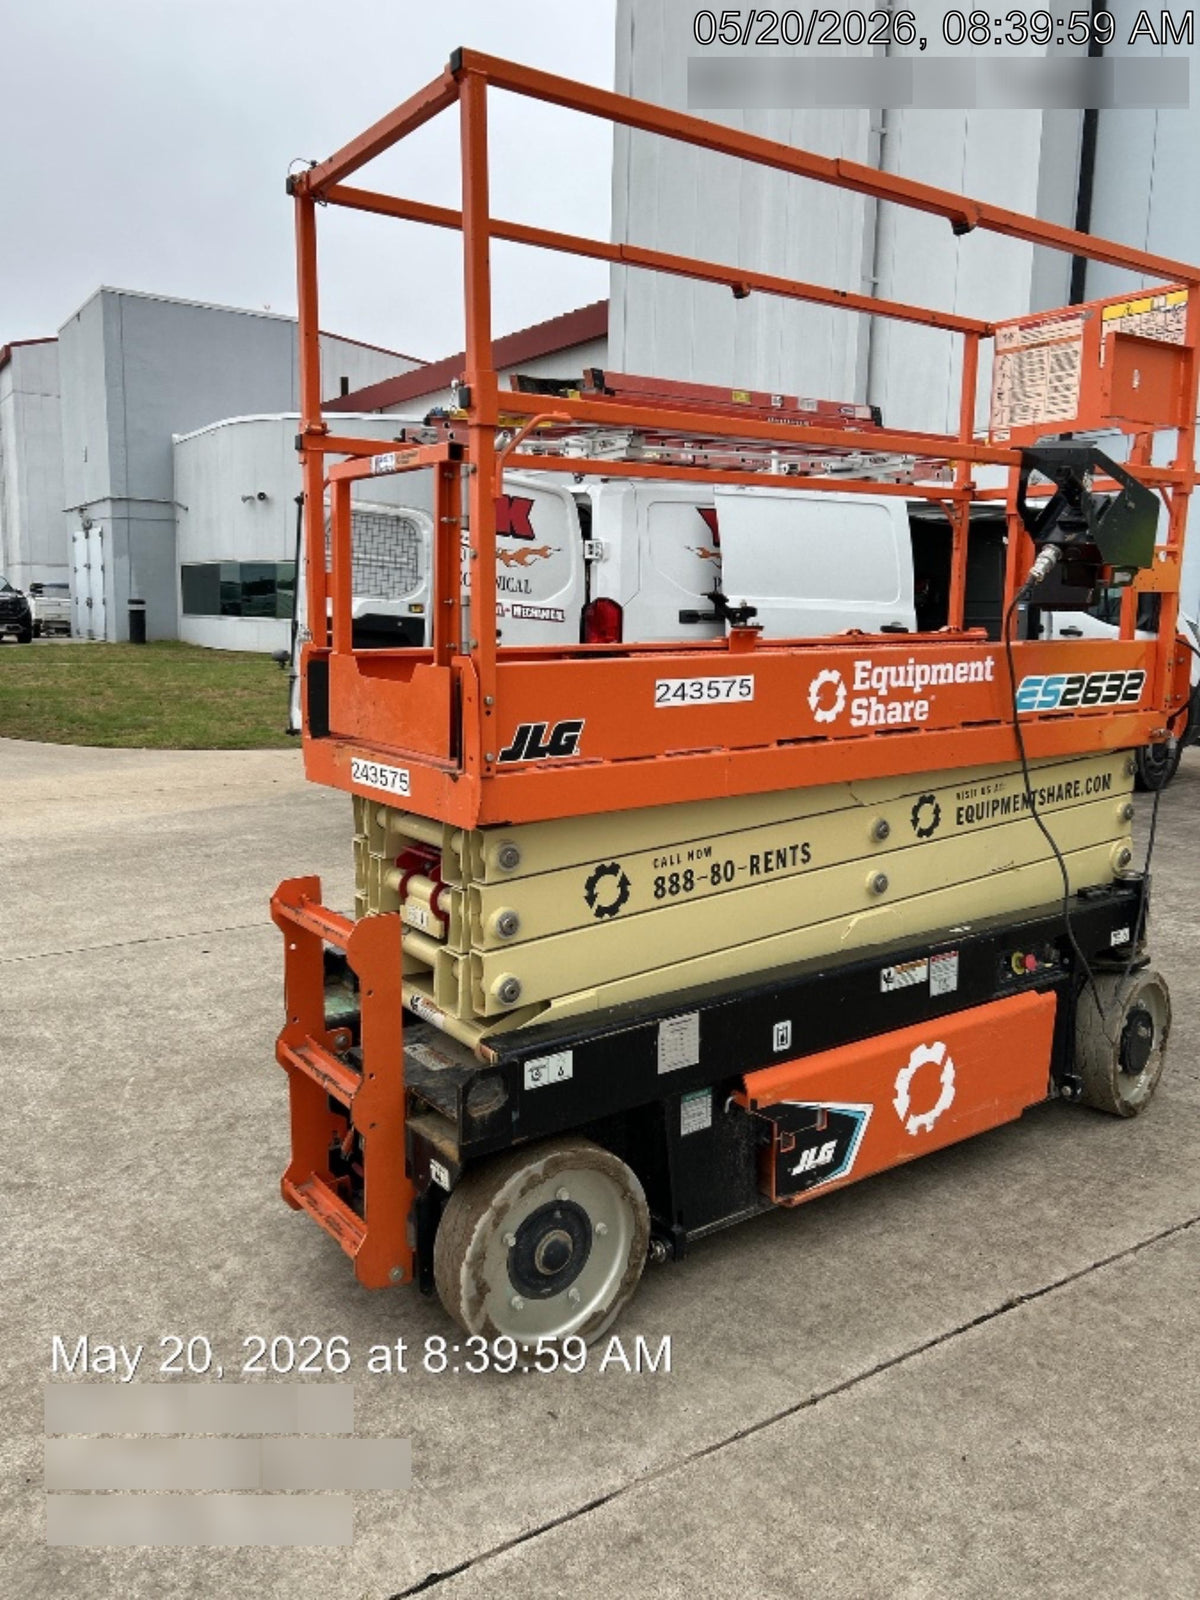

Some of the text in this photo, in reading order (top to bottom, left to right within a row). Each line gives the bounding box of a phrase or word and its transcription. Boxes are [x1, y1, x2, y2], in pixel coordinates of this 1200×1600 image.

[655, 677, 752, 703] 243575
[853, 656, 995, 691] Equipment
[1015, 669, 1147, 713] ES2632
[851, 697, 930, 727] Share
[496, 718, 585, 764] JLG
[352, 761, 409, 792] 243575
[956, 773, 1112, 825] EQUIPMENTSHARE.COM
[653, 846, 712, 869] CALL NOW
[653, 842, 812, 899] 888-80-RENTS
[791, 1140, 838, 1176] JLG
